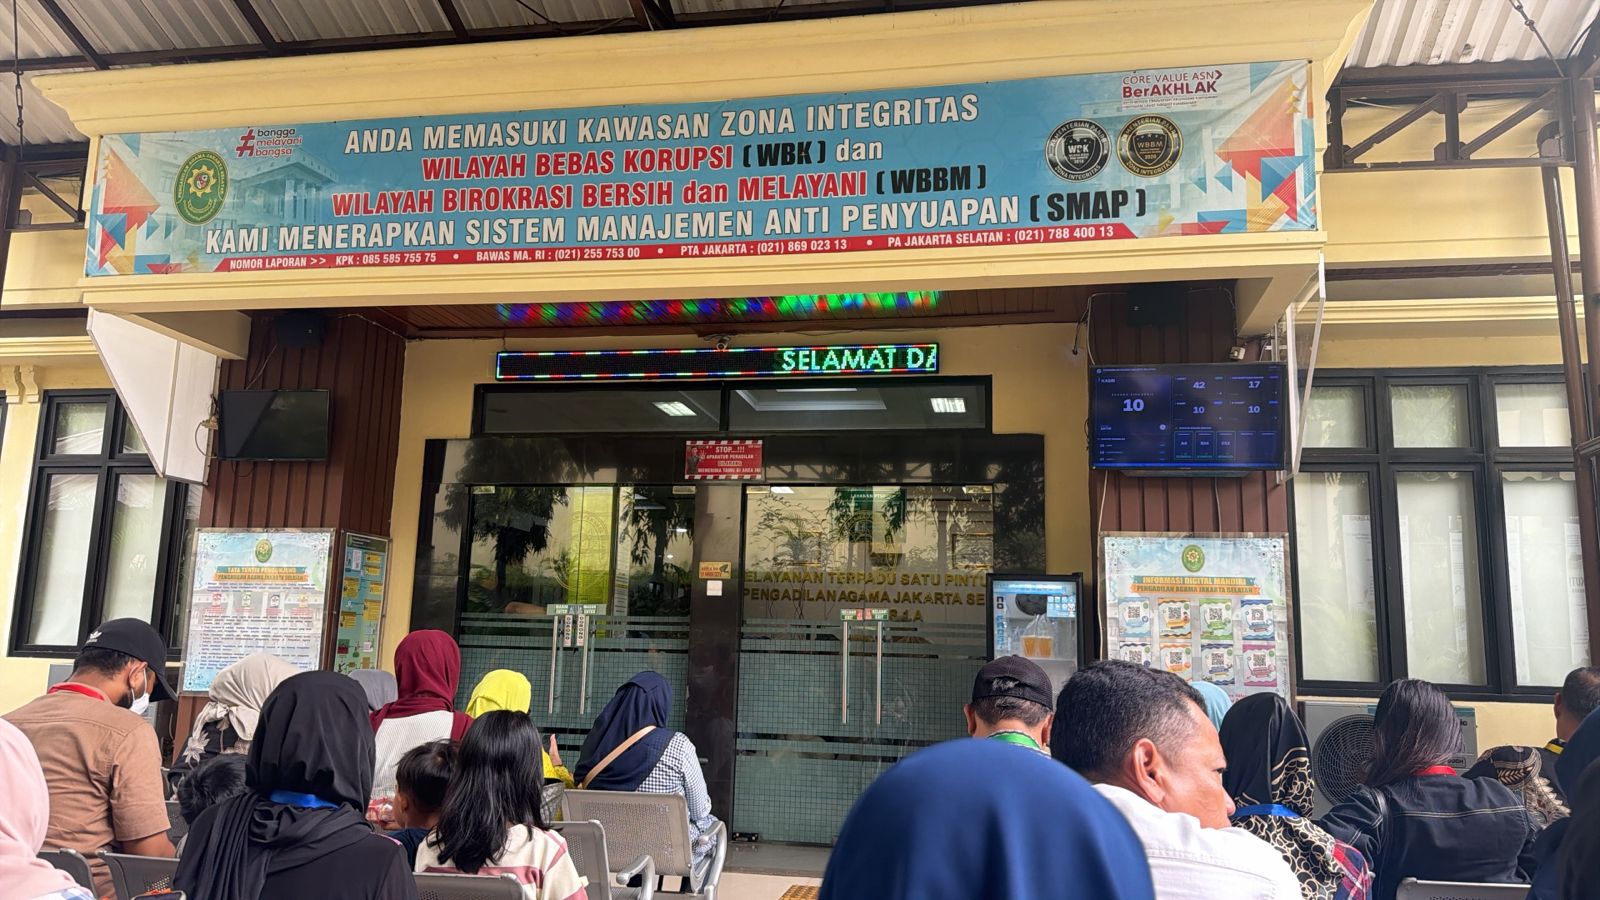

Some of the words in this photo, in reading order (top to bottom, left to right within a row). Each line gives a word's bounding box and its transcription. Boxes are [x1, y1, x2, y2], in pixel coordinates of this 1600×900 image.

[1123, 75, 1151, 85] CORE
[1155, 73, 1188, 83] VALUE
[1192, 71, 1214, 81] ASN
[1122, 81, 1218, 98] BerAKHLAK
[344, 127, 413, 154] ANDA
[423, 119, 566, 150] MEMASUKI
[577, 113, 709, 143] KAWASAN
[721, 107, 795, 137] ZONA
[807, 94, 978, 132] INTEGRITAS
[257, 128, 296, 138] bangga
[256, 137, 302, 147] melayani
[255, 147, 292, 158] bangsa
[422, 153, 526, 181] WILAYAH
[535, 151, 615, 177] BEBAS
[623, 145, 734, 174] KORUPSI
[835, 138, 883, 162] dan
[332, 189, 434, 217] WILAYAH
[442, 184, 573, 213] BIROKRASI
[582, 180, 673, 209] BERSIH
[682, 180, 728, 206] dan
[737, 171, 868, 203] MELAYANI
[205, 226, 268, 254] KAMI
[278, 220, 455, 251] MENERAPKAN
[465, 216, 565, 245] SISTEM
[576, 210, 753, 242] MANAJEMEN
[764, 206, 829, 235] ANTI
[842, 195, 1019, 232] PENYUAPAN
[887, 237, 902, 248] PA
[904, 234, 953, 247] JAKARTA
[956, 231, 1003, 245] SELATAN
[1014, 229, 1045, 243] (021)
[1048, 228, 1070, 239] 788
[1073, 227, 1096, 238] 400
[1099, 226, 1114, 237] 13
[476, 250, 511, 262] BAWAS
[513, 250, 532, 262] MA.
[554, 248, 581, 261] (021)
[583, 248, 603, 259] 255
[605, 248, 624, 258] 753
[627, 248, 640, 258] 00
[680, 246, 699, 256] PTA
[702, 244, 747, 255] JAKARTA
[757, 242, 784, 254] (021)
[788, 241, 808, 252] 869
[810, 240, 831, 251] 023
[834, 239, 847, 250] 13
[230, 258, 263, 270] NOMOR
[265, 256, 307, 269] LAPORAN
[362, 254, 381, 265] 085
[383, 253, 401, 264] 585
[403, 253, 422, 263] 755
[424, 252, 437, 263] 75
[781, 348, 896, 371] SELAMAT
[1192, 381, 1206, 389] 42
[1248, 380, 1261, 389] 17
[1123, 398, 1144, 412] 10
[1193, 406, 1205, 414] 10
[744, 571, 824, 583] ELAYANAN
[828, 572, 897, 586] TERPADU
[900, 573, 940, 586] SATU
[1143, 576, 1182, 584] INFORMASI
[743, 588, 836, 602] PENGADILAN
[838, 589, 890, 604] AGAMA
[893, 591, 963, 605] JAKARTA
